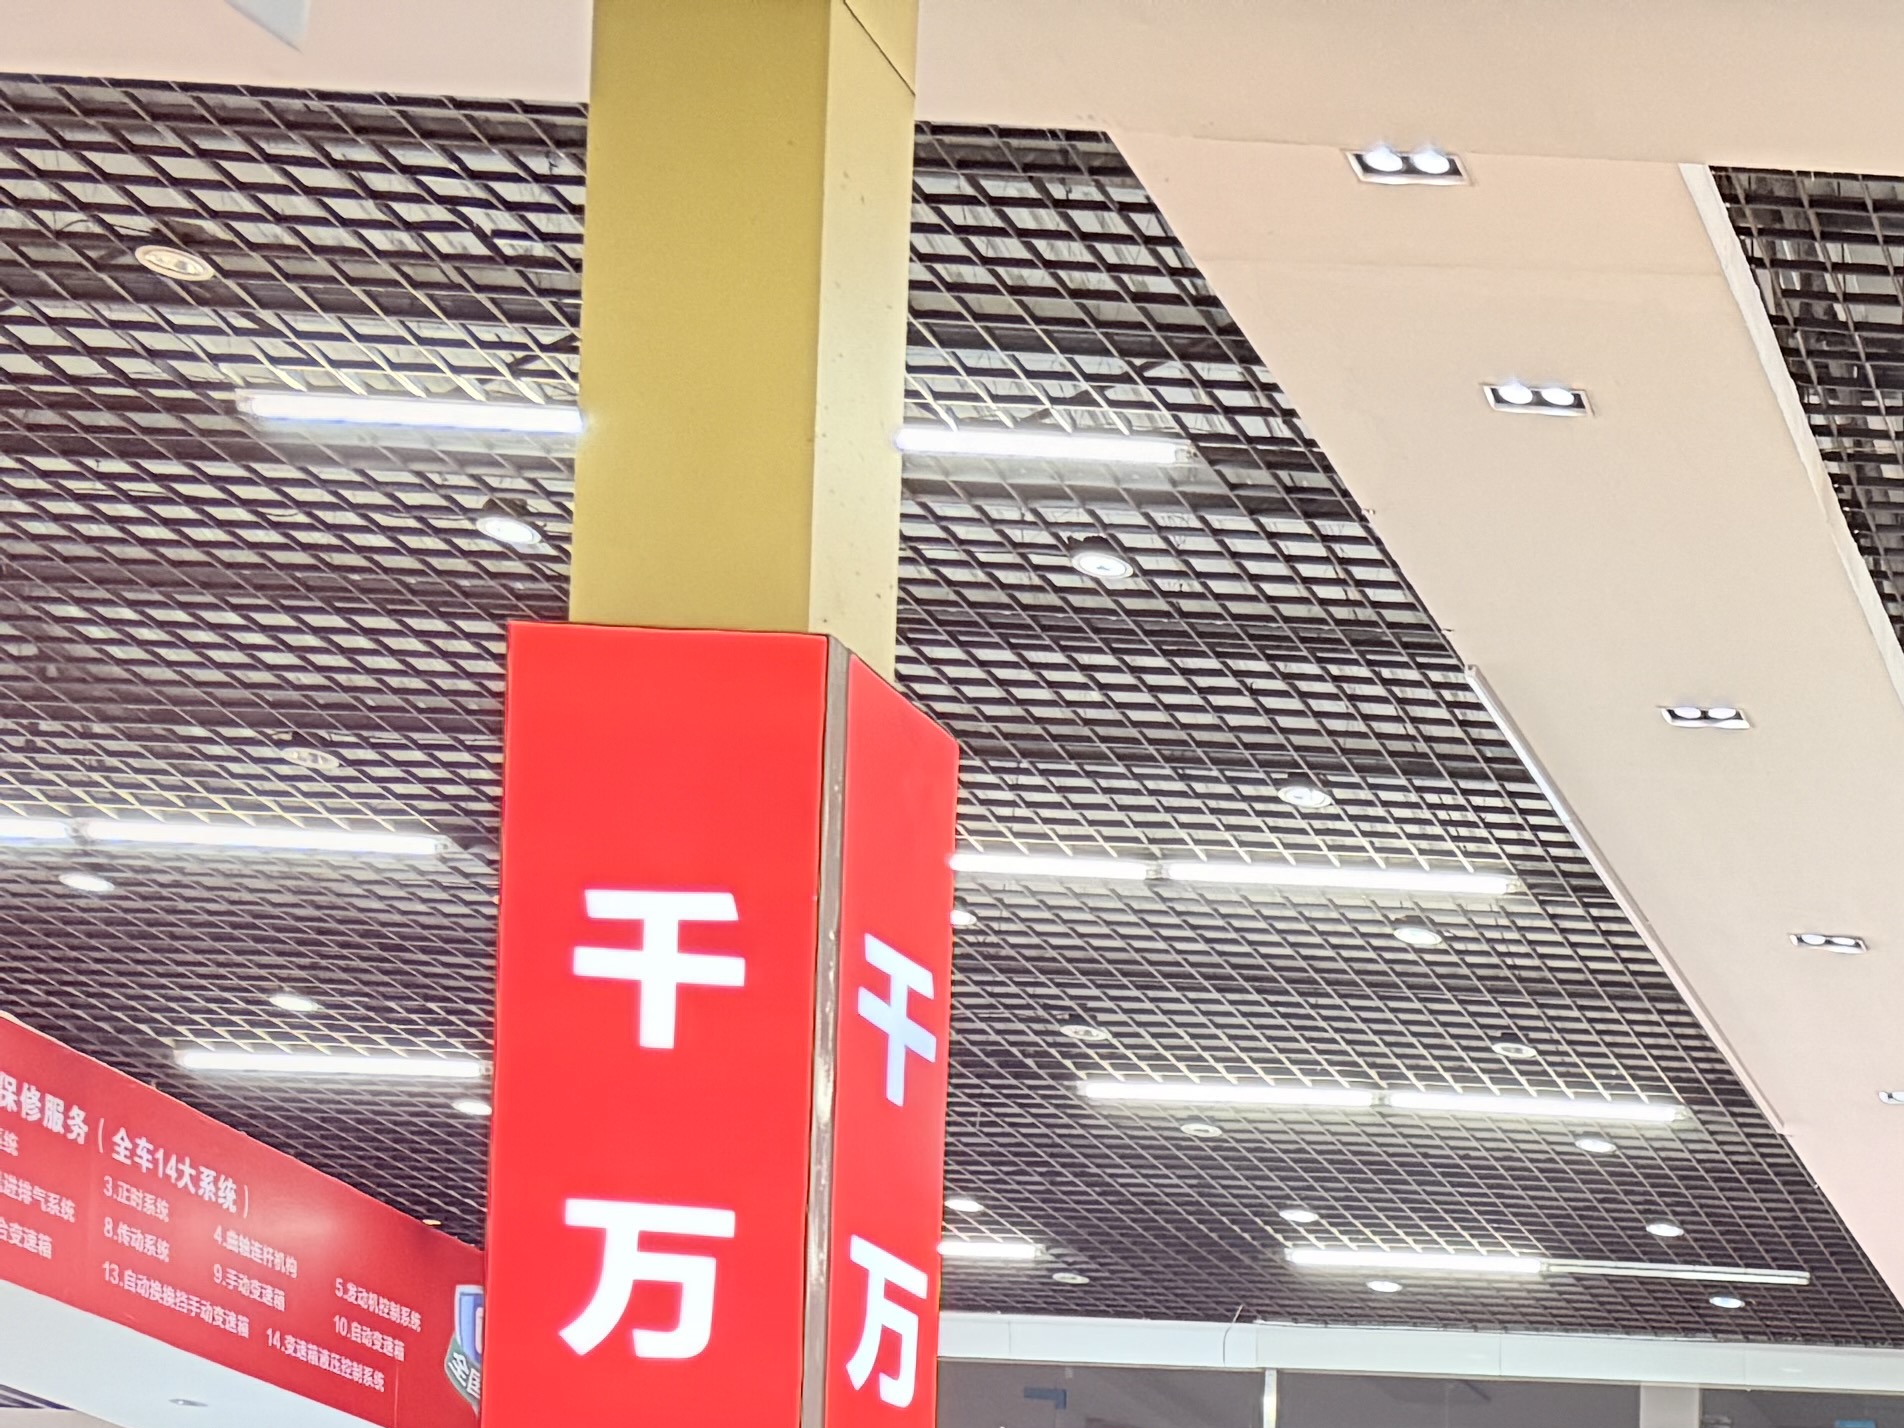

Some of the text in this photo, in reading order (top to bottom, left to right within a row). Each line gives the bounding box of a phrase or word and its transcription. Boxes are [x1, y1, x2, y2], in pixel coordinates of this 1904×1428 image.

[103, 1175, 170, 1223] 3.正时系统
[103, 1216, 170, 1263] 8.传动系统
